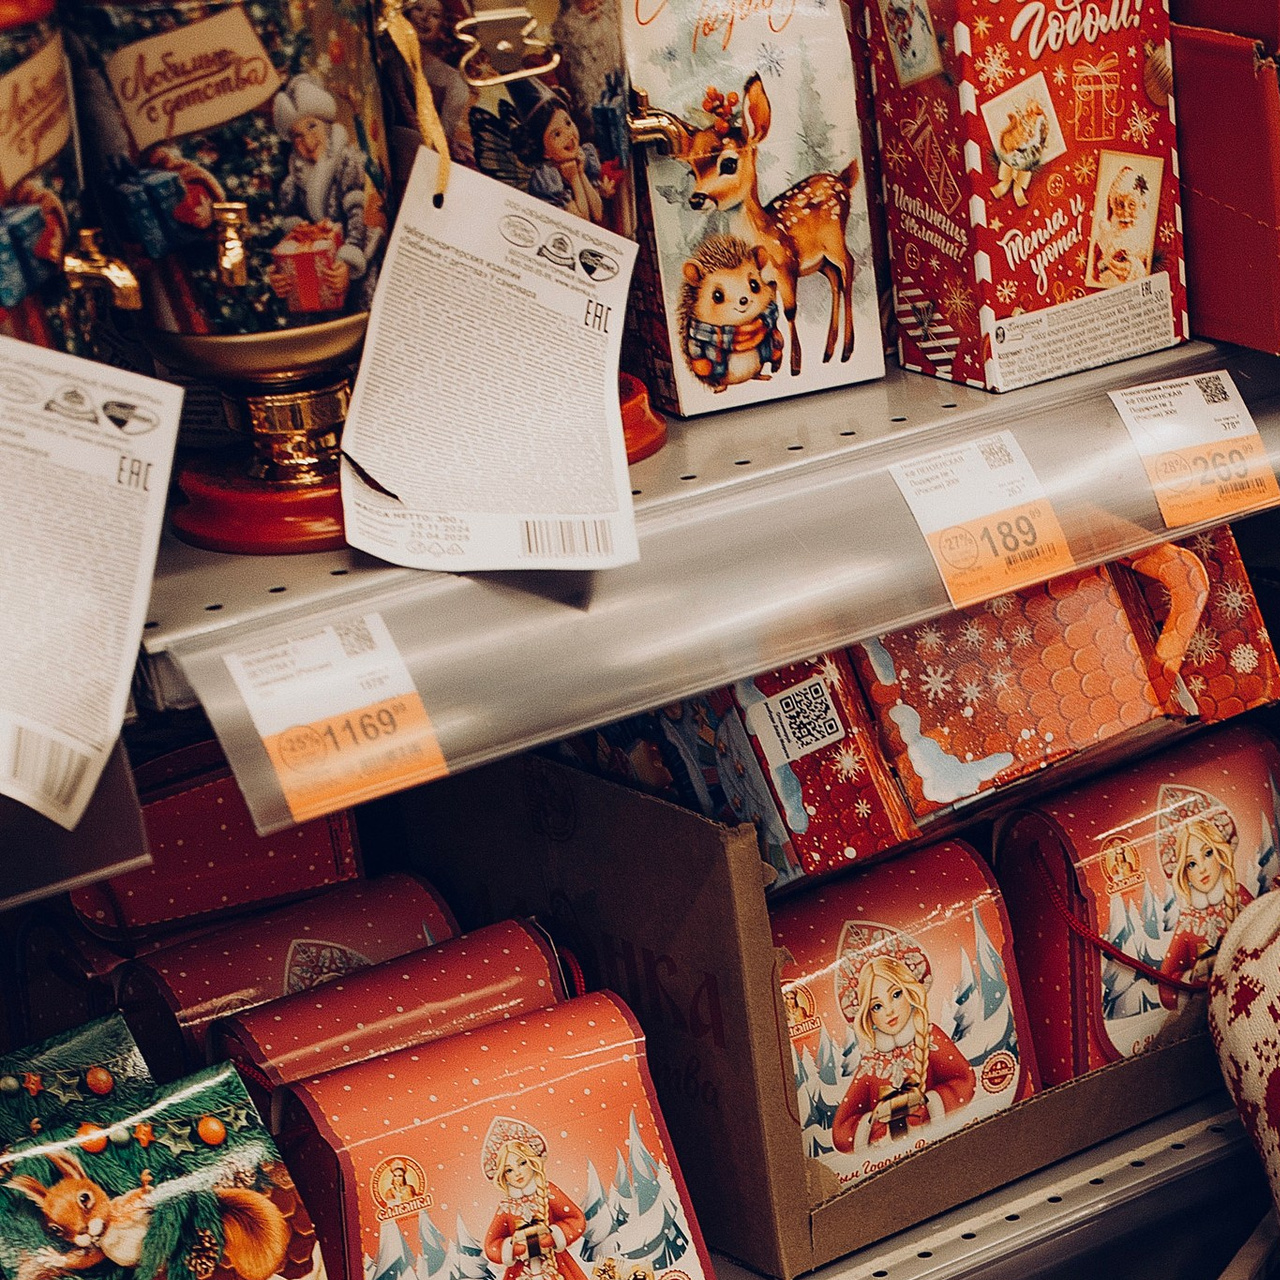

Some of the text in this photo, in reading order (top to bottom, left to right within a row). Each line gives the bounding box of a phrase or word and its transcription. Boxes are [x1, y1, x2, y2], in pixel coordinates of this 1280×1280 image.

[585, 299, 612, 333] EAC
[117, 456, 153, 491] EAC
[1192, 449, 1248, 485] 269
[980, 515, 1037, 558] 189
[323, 708, 398, 751] 1169
